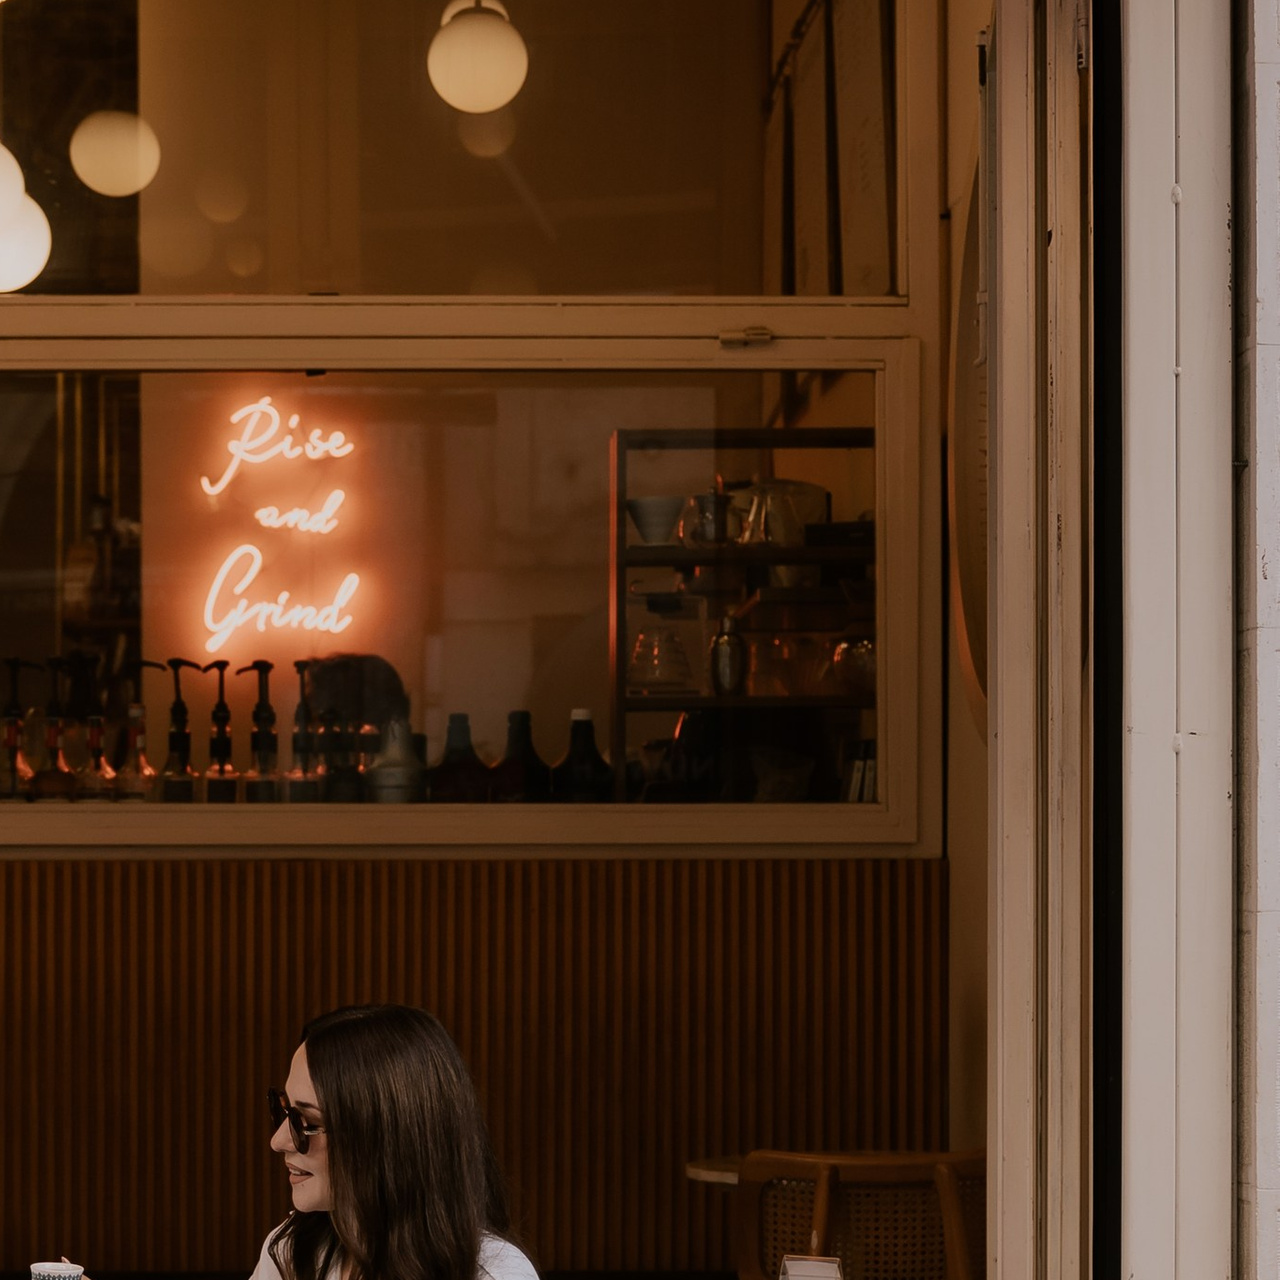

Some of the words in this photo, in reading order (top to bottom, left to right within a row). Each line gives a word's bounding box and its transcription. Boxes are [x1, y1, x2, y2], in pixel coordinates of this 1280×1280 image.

[200, 395, 355, 496] Rise
[254, 488, 346, 535] and
[203, 543, 361, 654] Grind
